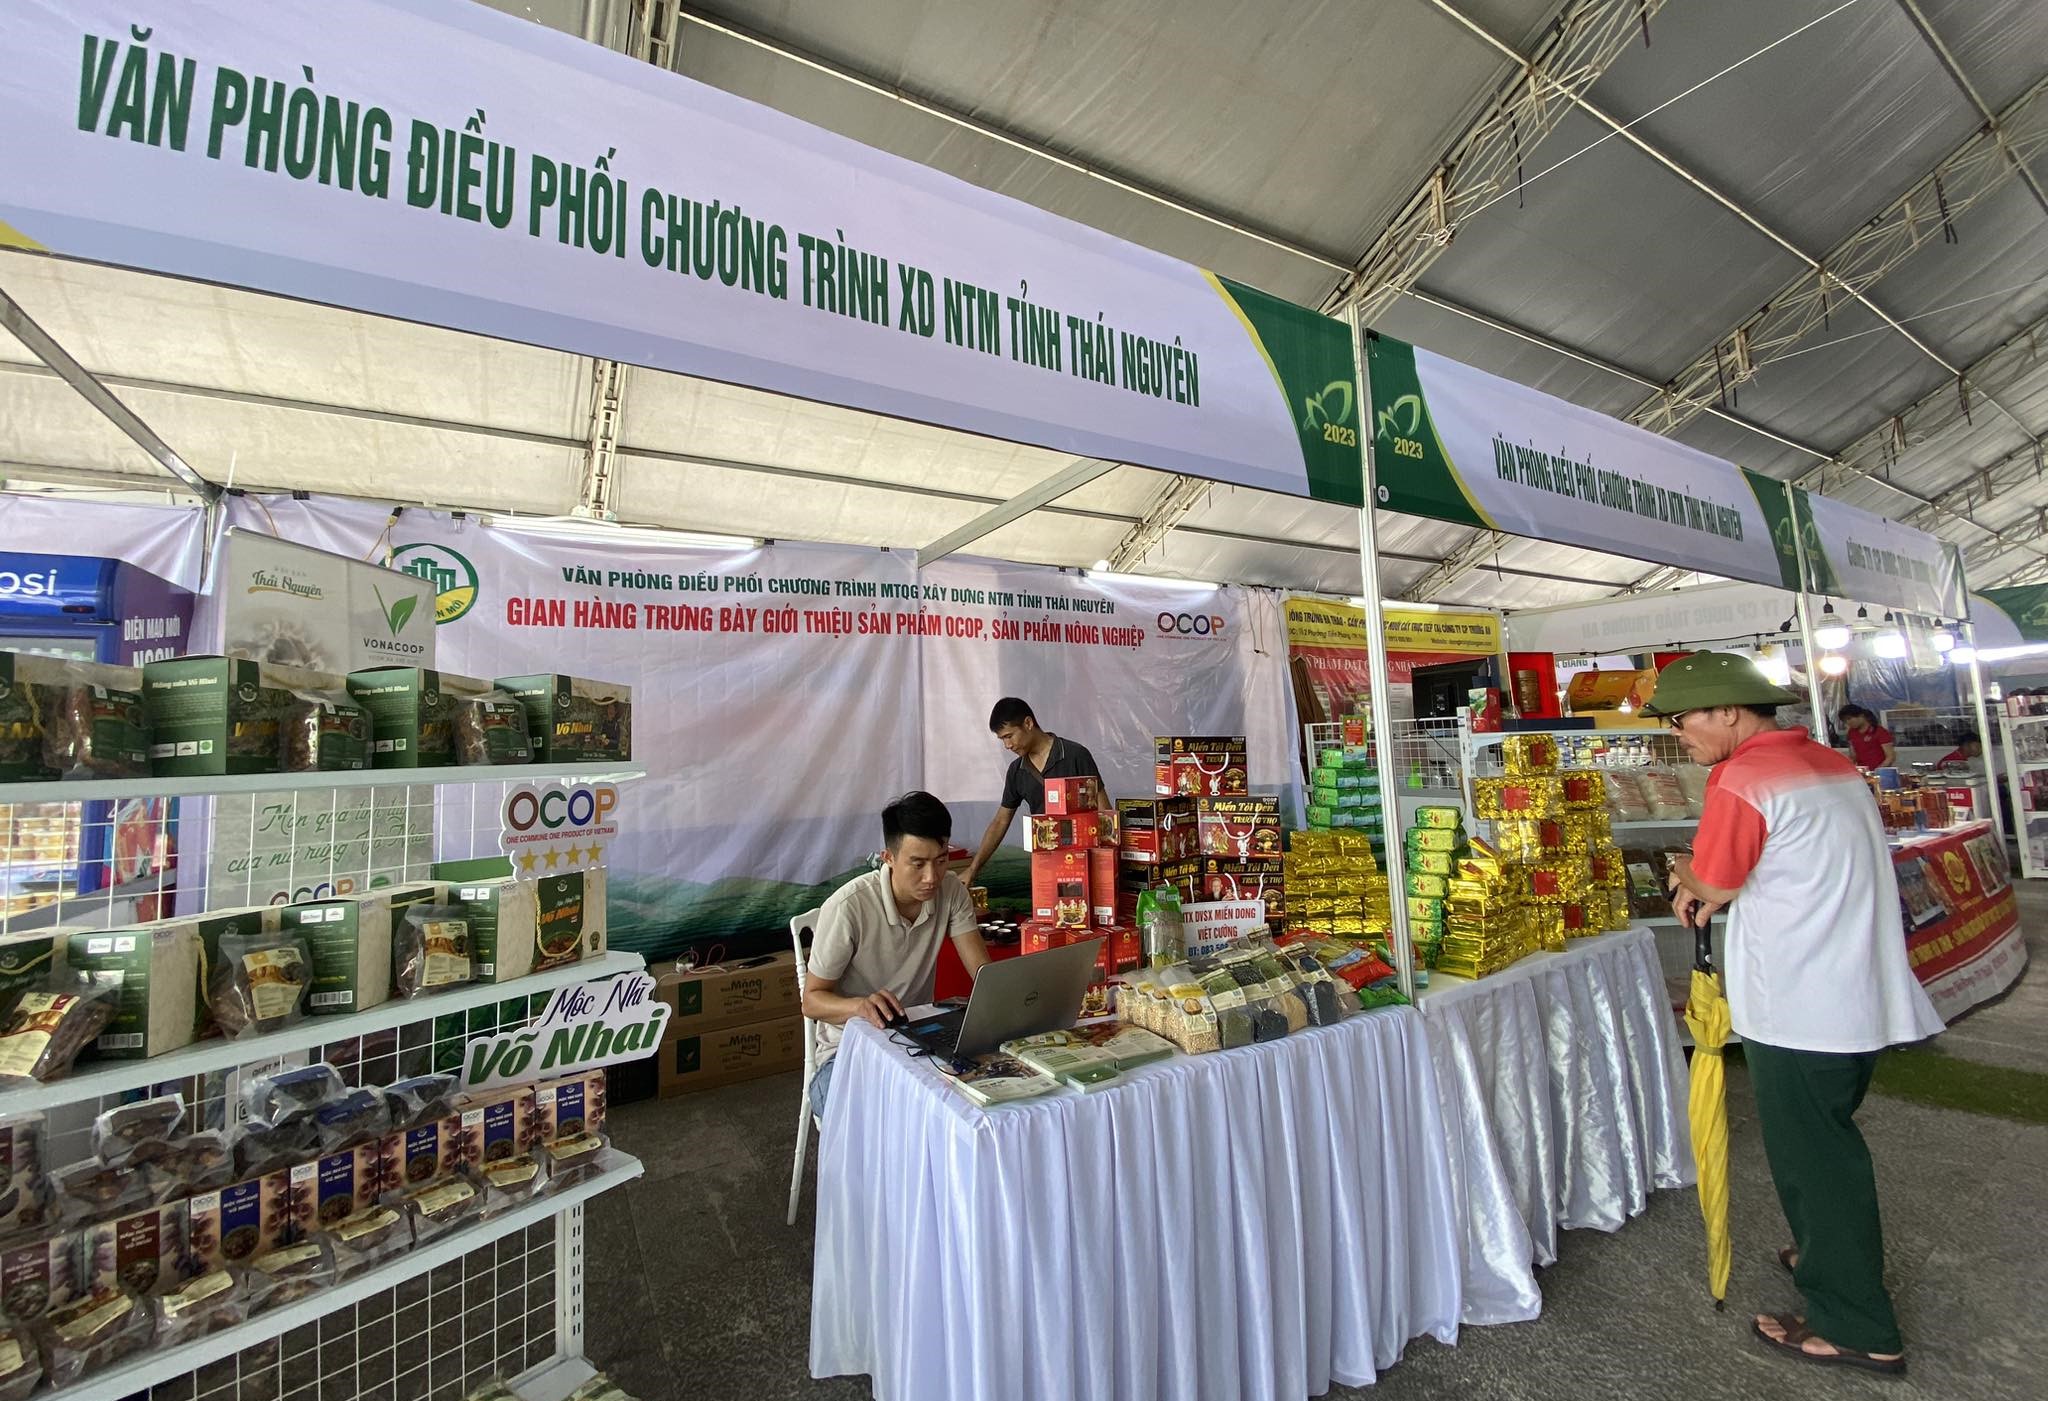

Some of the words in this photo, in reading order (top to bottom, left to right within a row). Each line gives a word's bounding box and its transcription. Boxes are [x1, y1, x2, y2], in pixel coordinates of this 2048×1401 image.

[76, 24, 196, 152] VĂN
[206, 64, 392, 199] PHÒNG
[406, 109, 515, 229] ĐIỀU
[529, 147, 627, 258] PHỐI
[641, 187, 788, 300] CHƯƠNG
[798, 228, 889, 327] TRÌNH
[898, 262, 935, 339] XD
[944, 277, 1000, 356] NTM
[1007, 279, 1061, 373] TỈNH
[1067, 311, 1115, 386] THÁI
[1121, 336, 1199, 408] NGUYÊN
[1323, 422, 1356, 448] 2023
[1393, 436, 1424, 460] 2023
[1492, 432, 1517, 483] VĂN
[1515, 439, 1553, 492] PHÒNG
[252, 569, 281, 588] Thái
[282, 576, 322, 598] Nguyên
[562, 565, 601, 586] VĂN
[609, 568, 672, 591] PHÒNG
[679, 569, 718, 592] ĐIỀU
[724, 571, 763, 593] PHỐI
[768, 577, 830, 596] CHƯƠNG
[835, 577, 877, 598] TRÌNH
[922, 583, 947, 601] XÂY
[951, 588, 984, 606] DỰNG
[988, 590, 1014, 606] NTM
[1017, 590, 1042, 609] TỈNH
[1044, 592, 1069, 611] THÁI
[1072, 595, 1115, 614] NGUYÊN
[124, 616, 144, 643] DIỆN
[507, 597, 566, 627] GIAN
[574, 595, 636, 630] HÀNG
[644, 602, 713, 632] TRƯNG
[720, 602, 756, 633] BÀY
[763, 602, 798, 633] GIỚI
[804, 607, 852, 639] THIỆU
[858, 603, 891, 635] SẢN
[896, 606, 942, 637] PHẨM
[992, 611, 1020, 640] SẢN
[1023, 614, 1061, 643] PHẨM
[1065, 620, 1100, 645] NÔNG
[1102, 624, 1145, 651] NGHIỆP
[1157, 612, 1225, 635] OCOP
[363, 638, 425, 654] VONACOOP
[556, 721, 571, 736] Võ
[508, 788, 616, 831] OCOP
[1213, 800, 1237, 812] Miến
[1238, 802, 1253, 812] Tỏi
[1255, 802, 1275, 812] Đen
[506, 836, 518, 844] ONE
[549, 832, 561, 840] ONE
[561, 830, 586, 839] PRODUCT
[1197, 926, 1212, 942] VIỆT
[541, 985, 594, 1027] Mộc
[600, 976, 650, 1017] Nhĩ
[468, 1031, 540, 1086] Võ
[540, 1008, 666, 1070] Nhai
